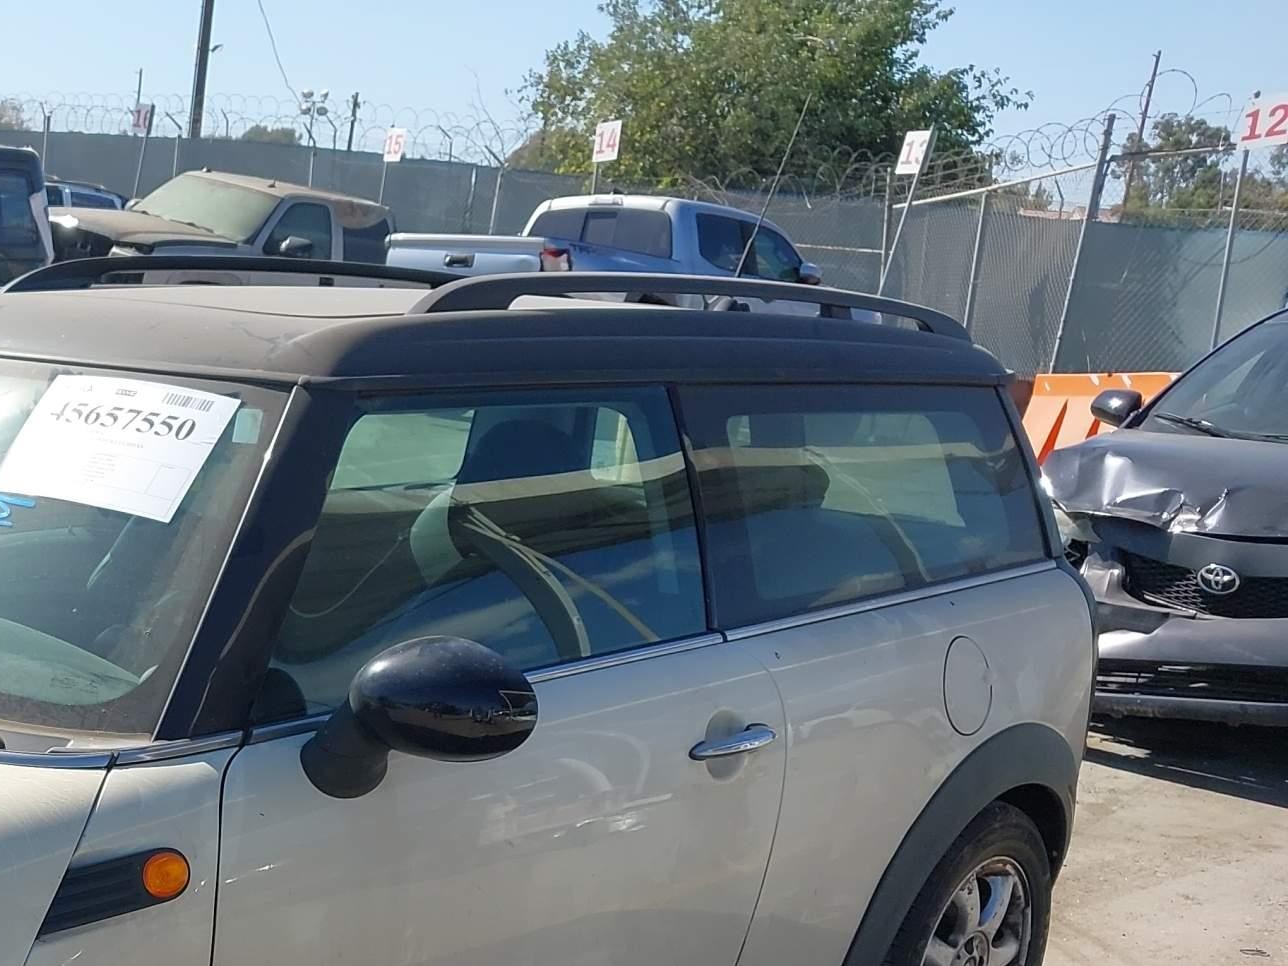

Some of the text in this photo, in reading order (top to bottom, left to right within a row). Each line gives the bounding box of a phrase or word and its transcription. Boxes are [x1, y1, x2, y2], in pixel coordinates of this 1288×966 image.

[1241, 104, 1288, 141] 12
[386, 134, 403, 154] 15
[596, 128, 616, 154] 14
[50, 401, 197, 441] 45657550
